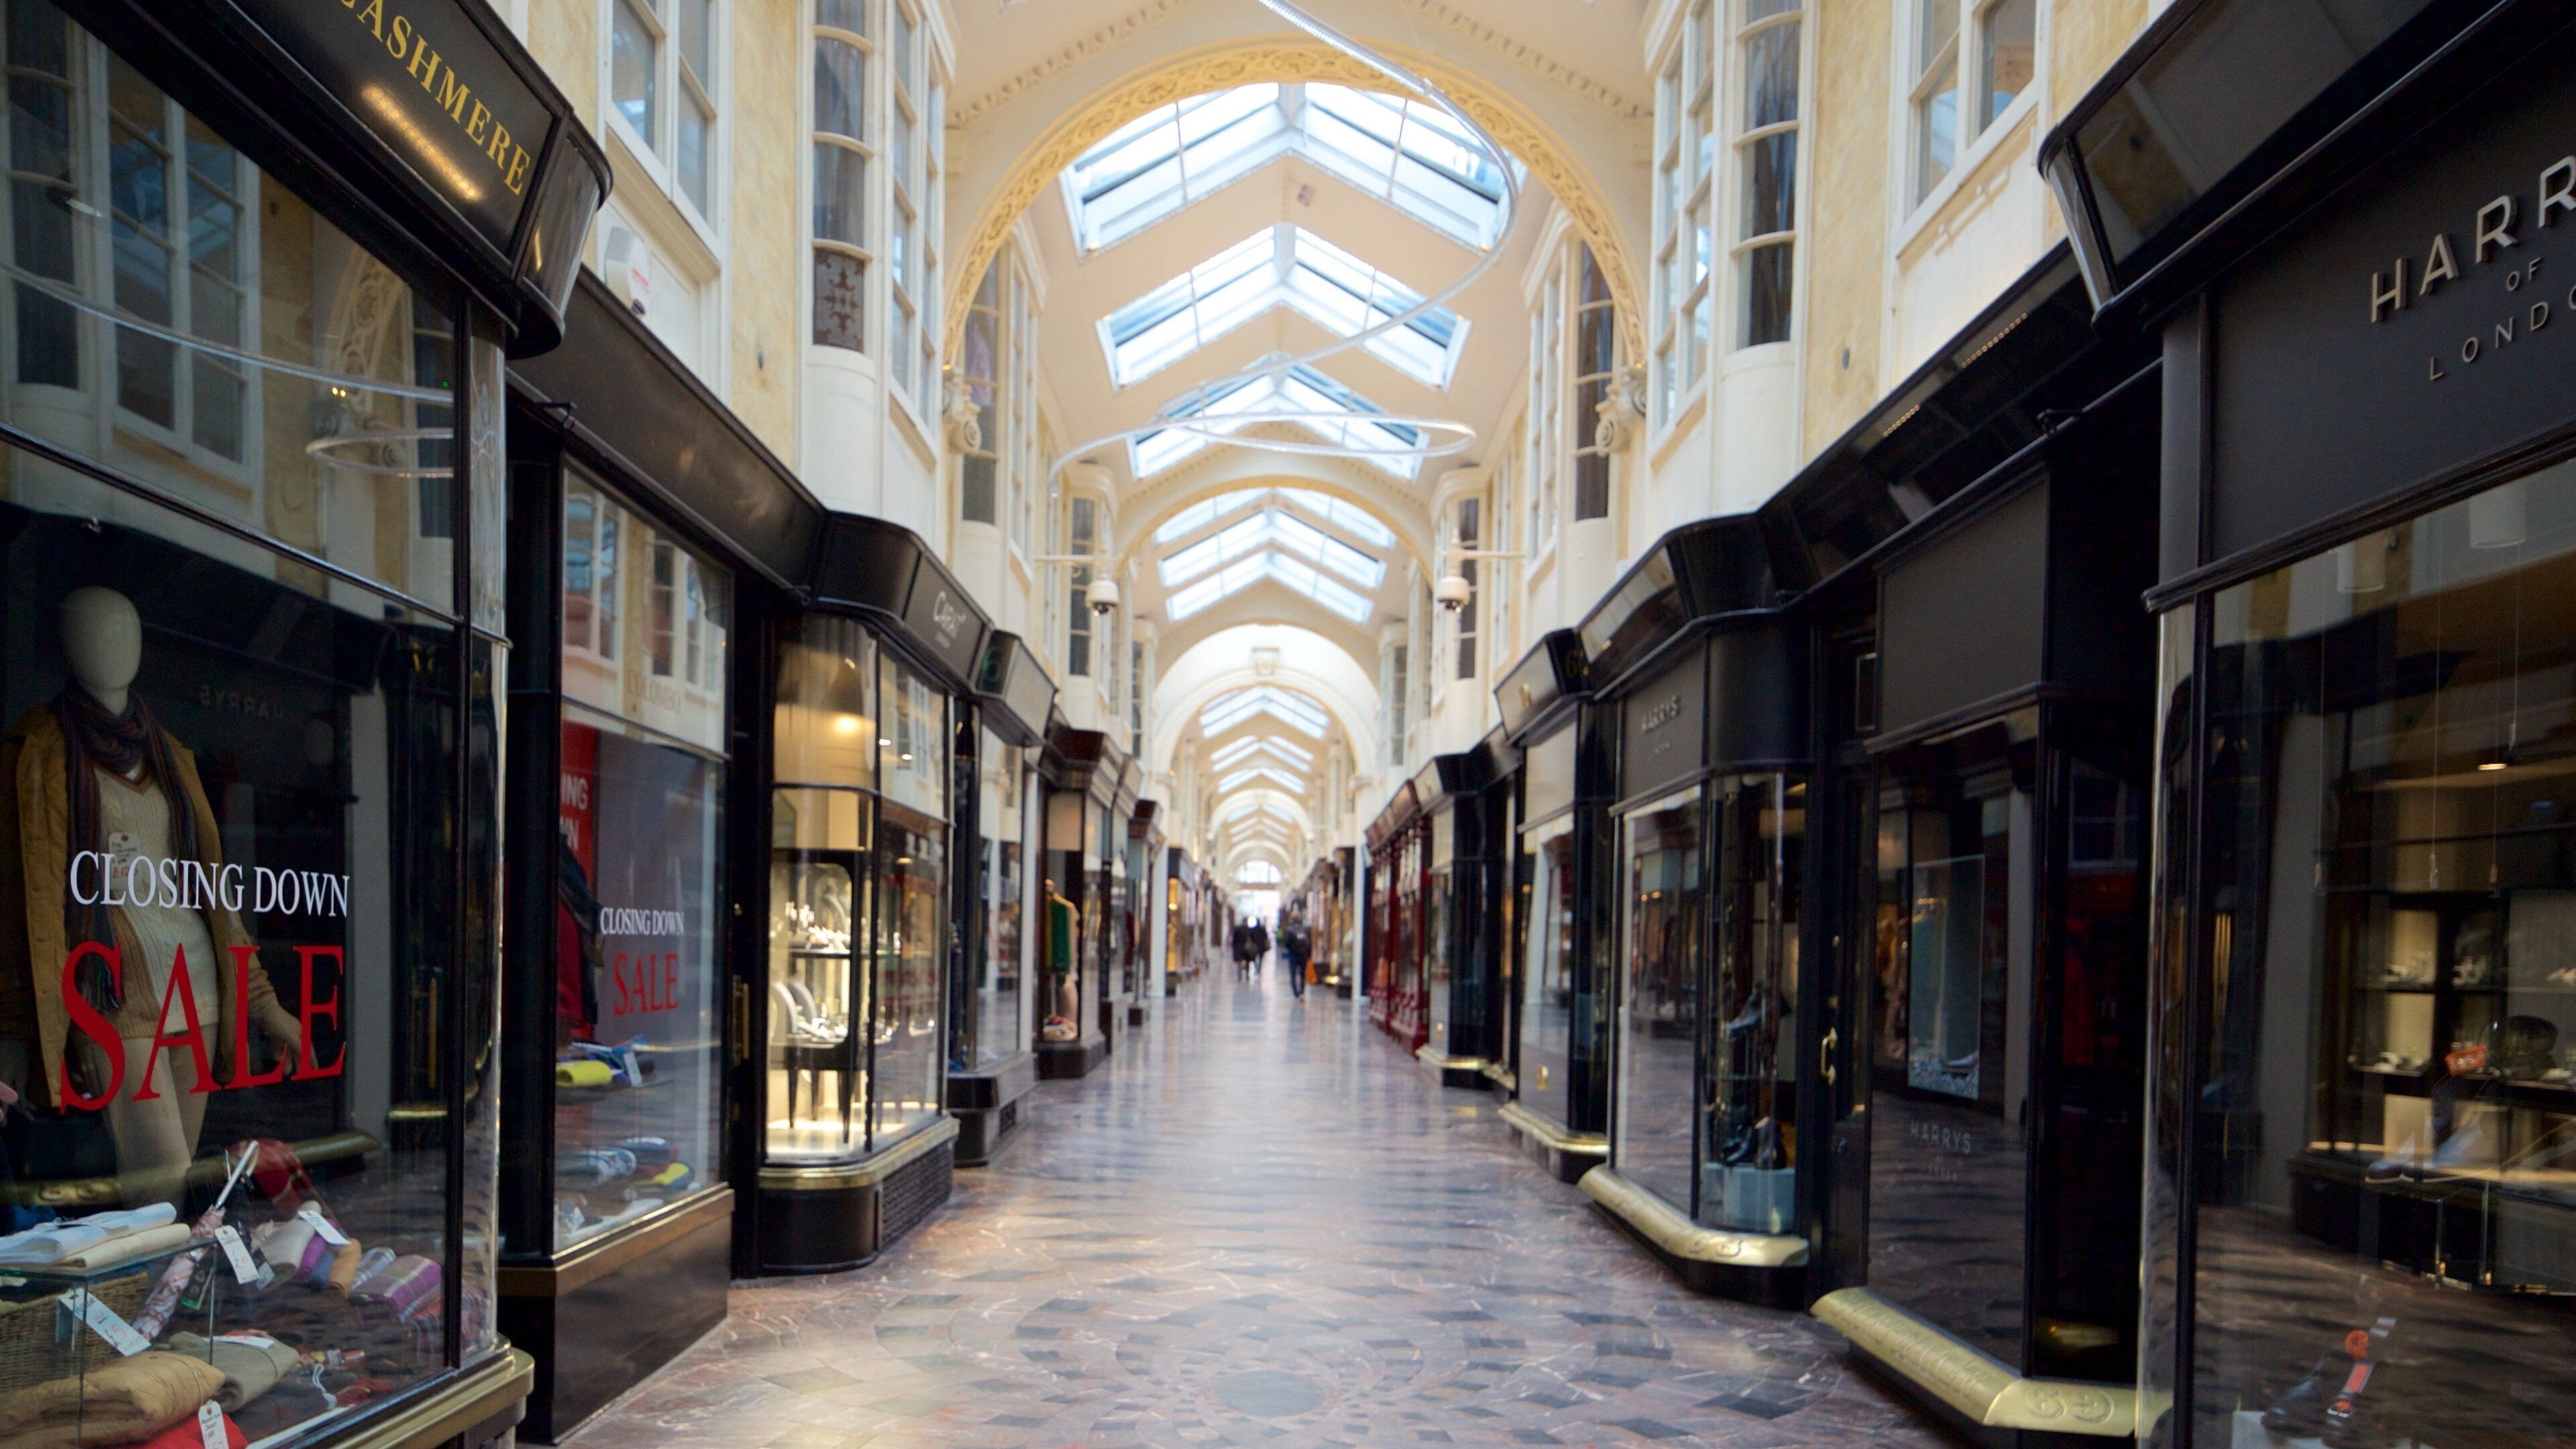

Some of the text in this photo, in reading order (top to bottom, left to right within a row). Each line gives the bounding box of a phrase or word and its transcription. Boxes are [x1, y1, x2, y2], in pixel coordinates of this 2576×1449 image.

[339, 0, 531, 196] ASHMERE
[2506, 256, 2543, 291] OF
[70, 850, 350, 918] CLOSING DOWN
[600, 906, 684, 936] CLOSING DOWN
[613, 952, 680, 1016] SALE
[60, 941, 347, 1115] SALE
[1910, 1120, 1972, 1154] HARRYS
